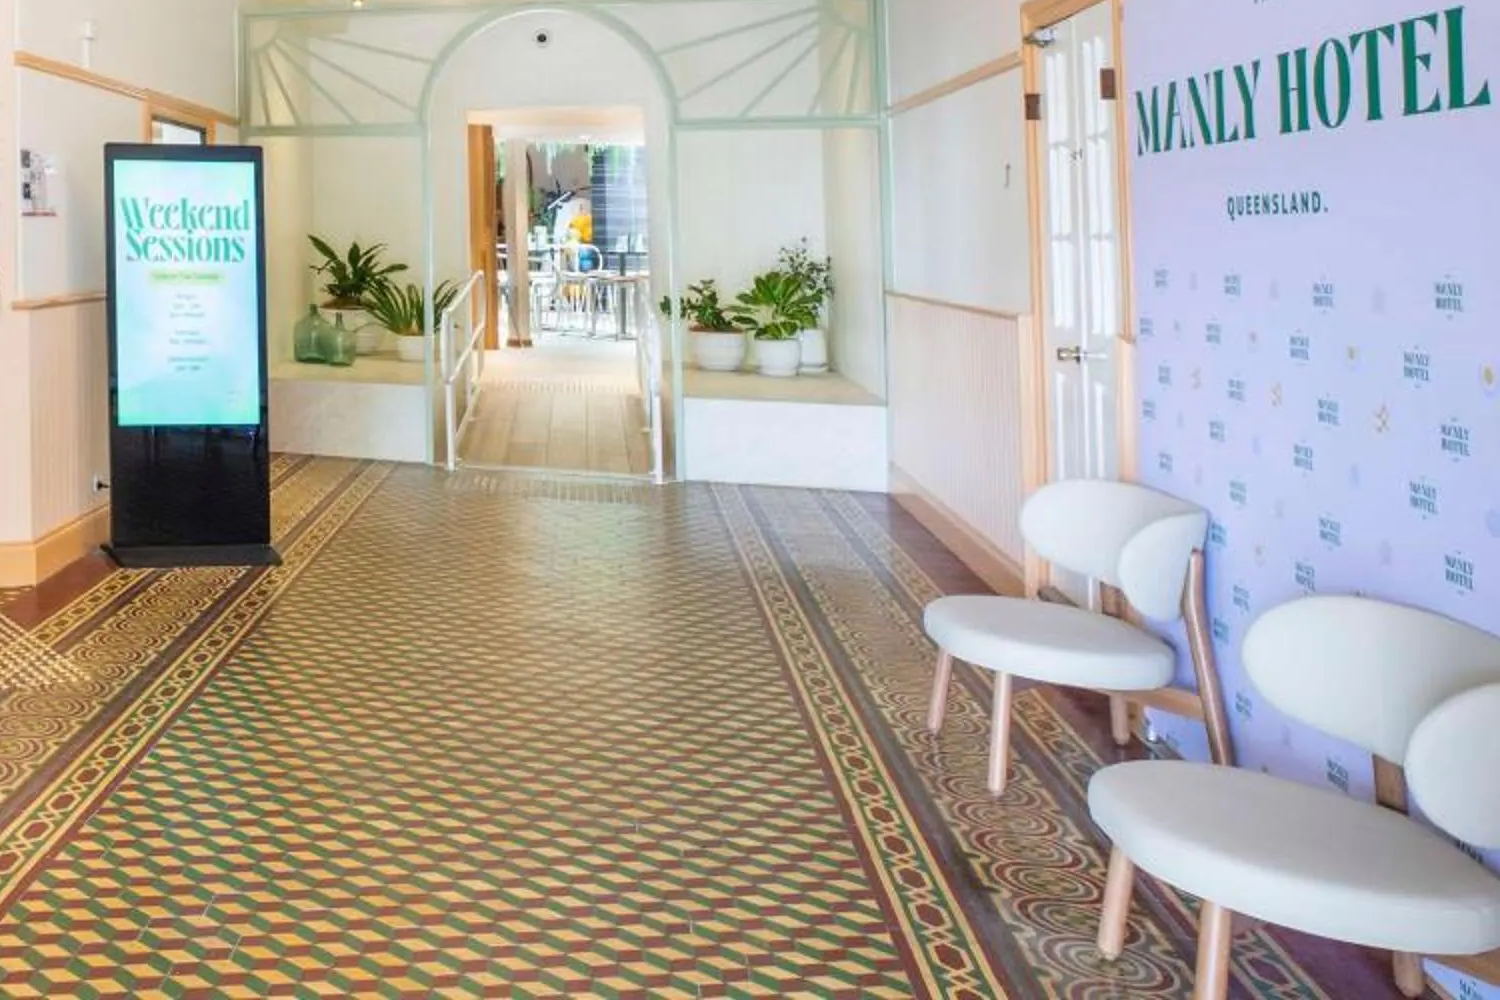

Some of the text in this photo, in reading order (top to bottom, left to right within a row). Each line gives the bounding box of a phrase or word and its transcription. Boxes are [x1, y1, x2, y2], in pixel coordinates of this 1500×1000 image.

[1135, 5, 1491, 156] MANLY HOTEL
[119, 197, 250, 232] Weekend
[1227, 191, 1329, 221] QUEENSLAND.
[125, 228, 245, 263] Sessions
